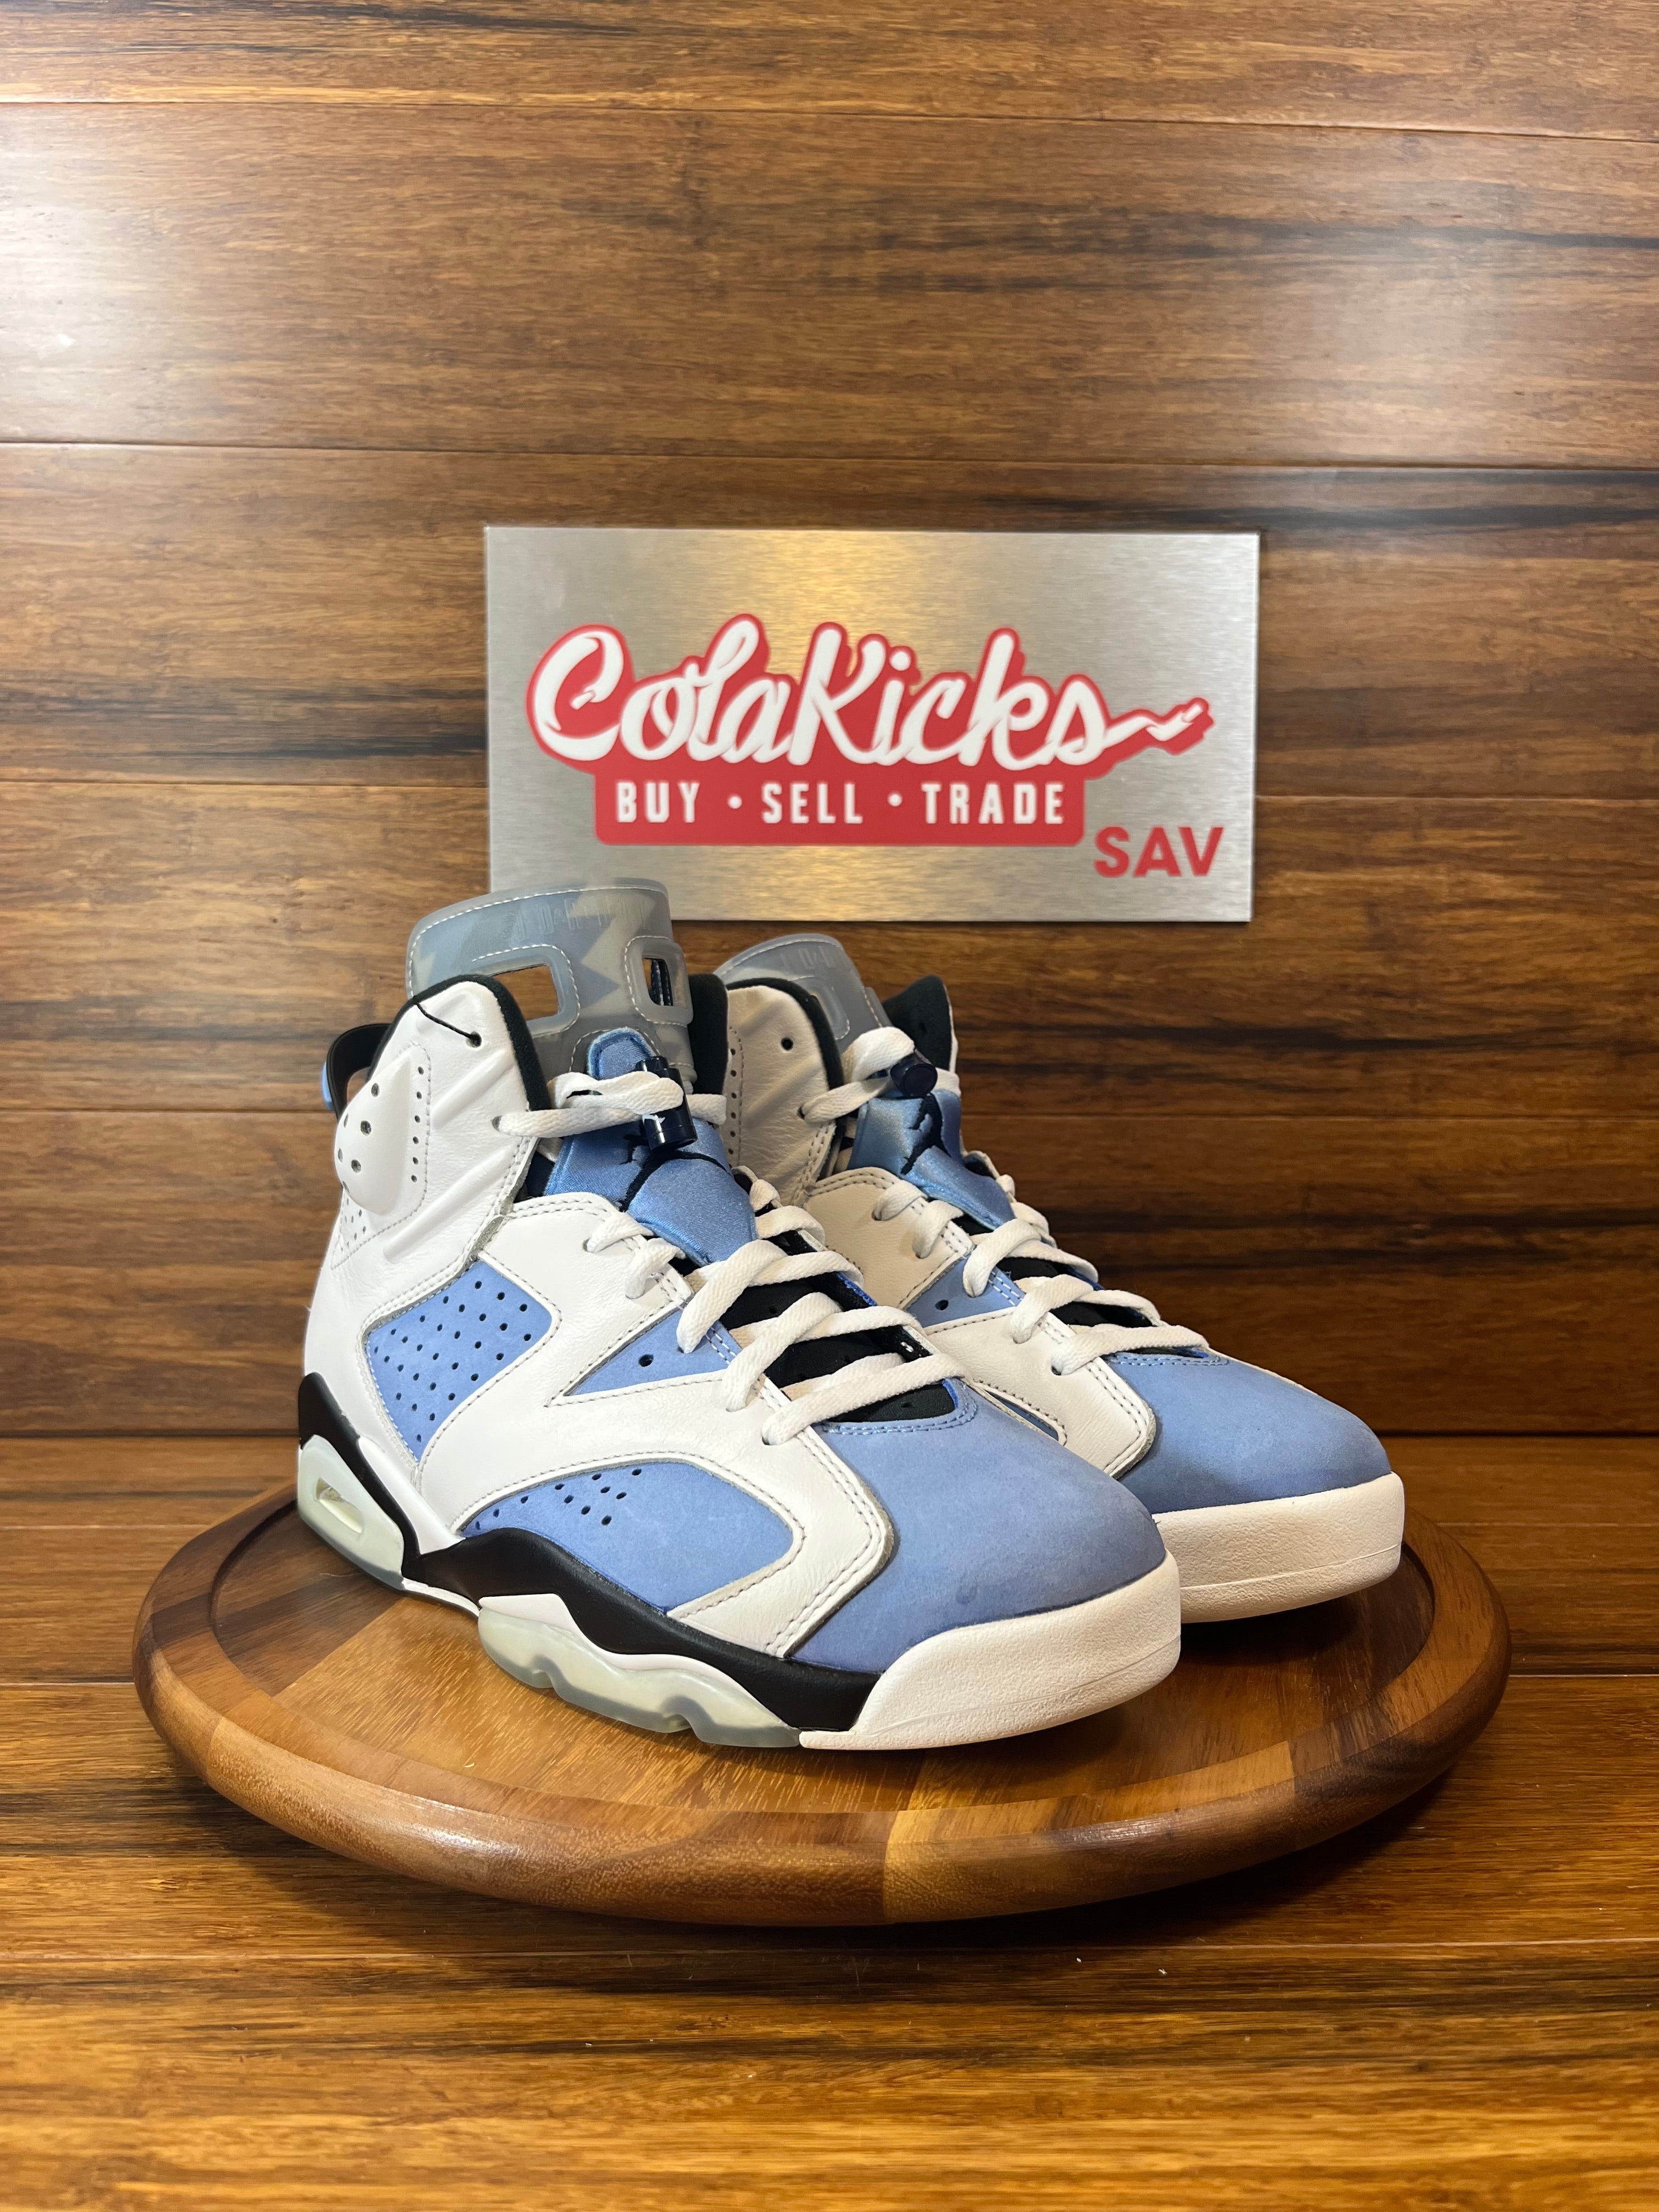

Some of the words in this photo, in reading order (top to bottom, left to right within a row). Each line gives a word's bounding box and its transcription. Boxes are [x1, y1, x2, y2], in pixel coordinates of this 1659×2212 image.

[533, 619, 1205, 771] ColaKicks
[617, 781, 699, 823] BUY
[761, 782, 862, 824] SELL
[922, 783, 1064, 825] TRADE
[1094, 826, 1224, 877] SAV
